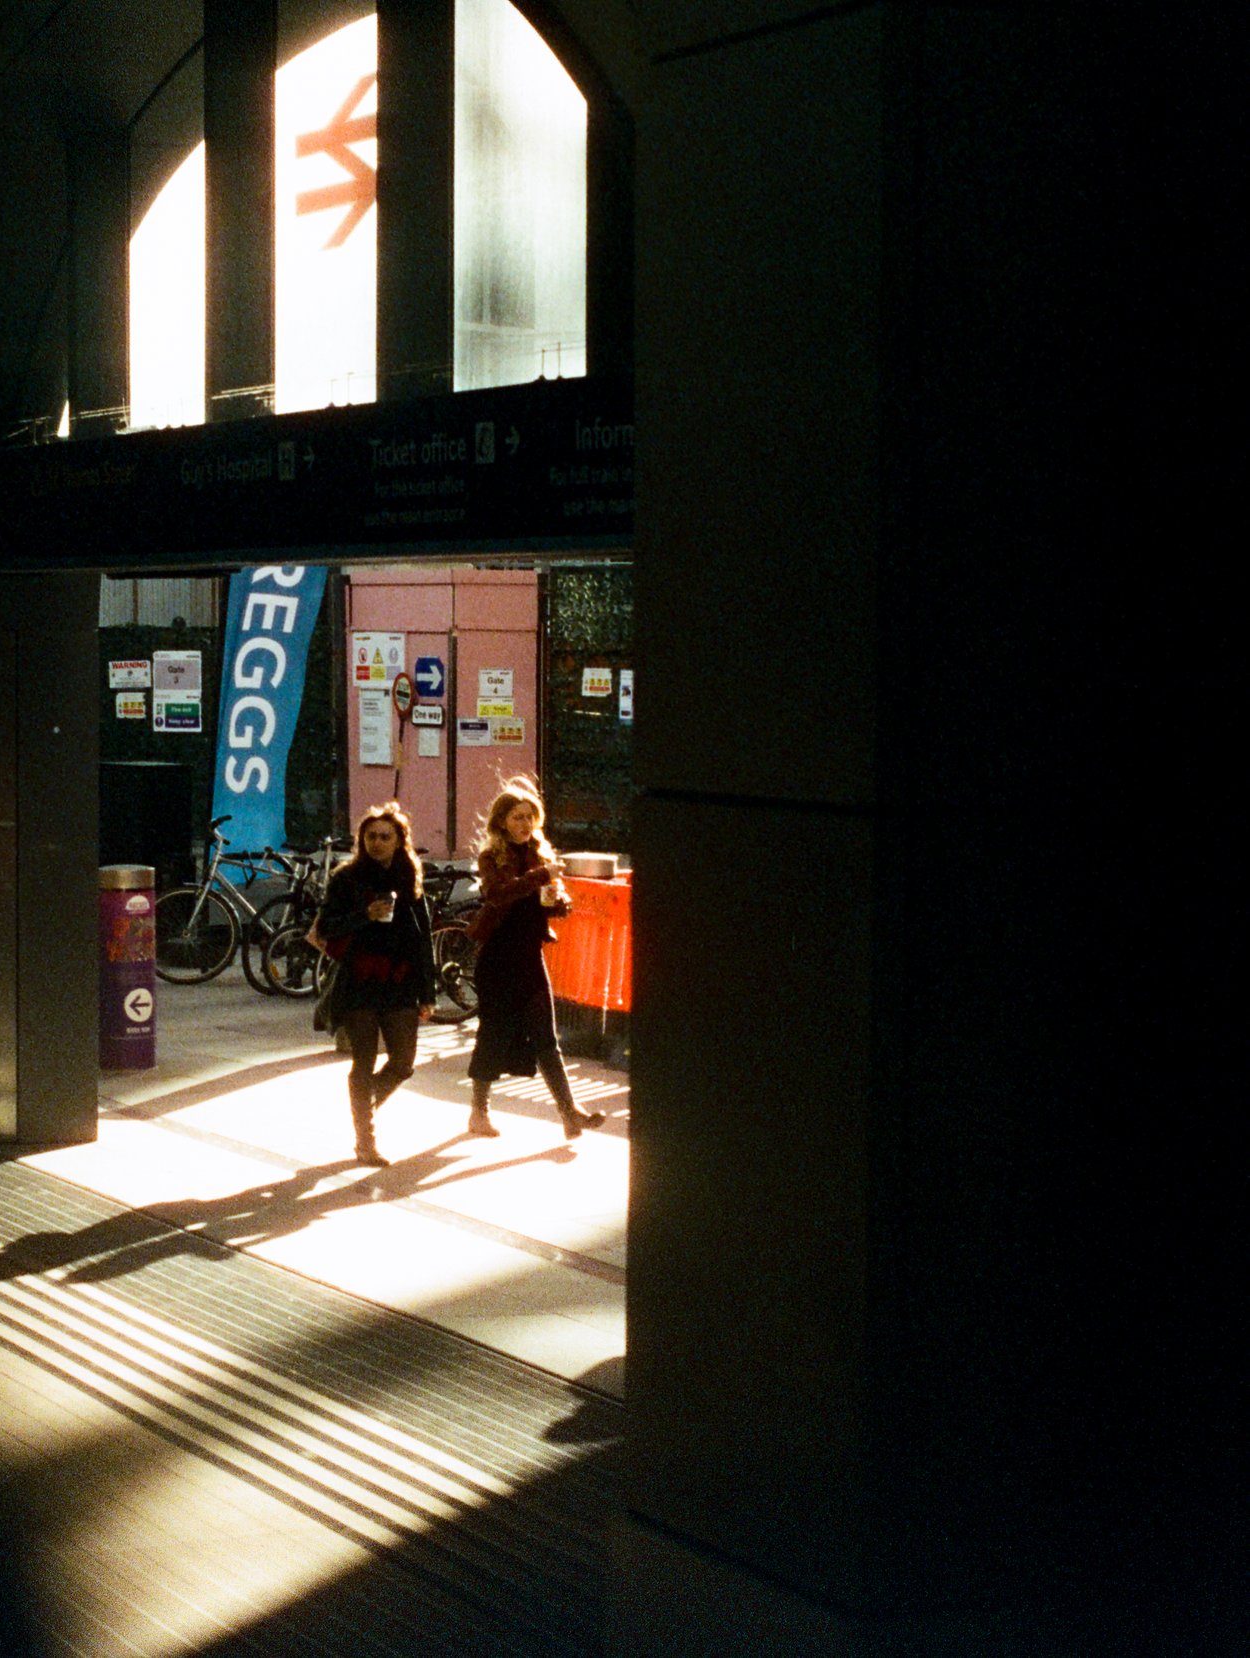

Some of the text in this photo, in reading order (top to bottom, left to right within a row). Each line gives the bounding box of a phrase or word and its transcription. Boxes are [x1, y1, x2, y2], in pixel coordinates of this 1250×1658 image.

[368, 430, 468, 469] Ticket office
[180, 457, 214, 491] Guy's
[216, 448, 273, 486] Hospital
[111, 662, 148, 670] WARNING
[487, 676, 504, 685] Gate
[414, 708, 441, 723] One way
